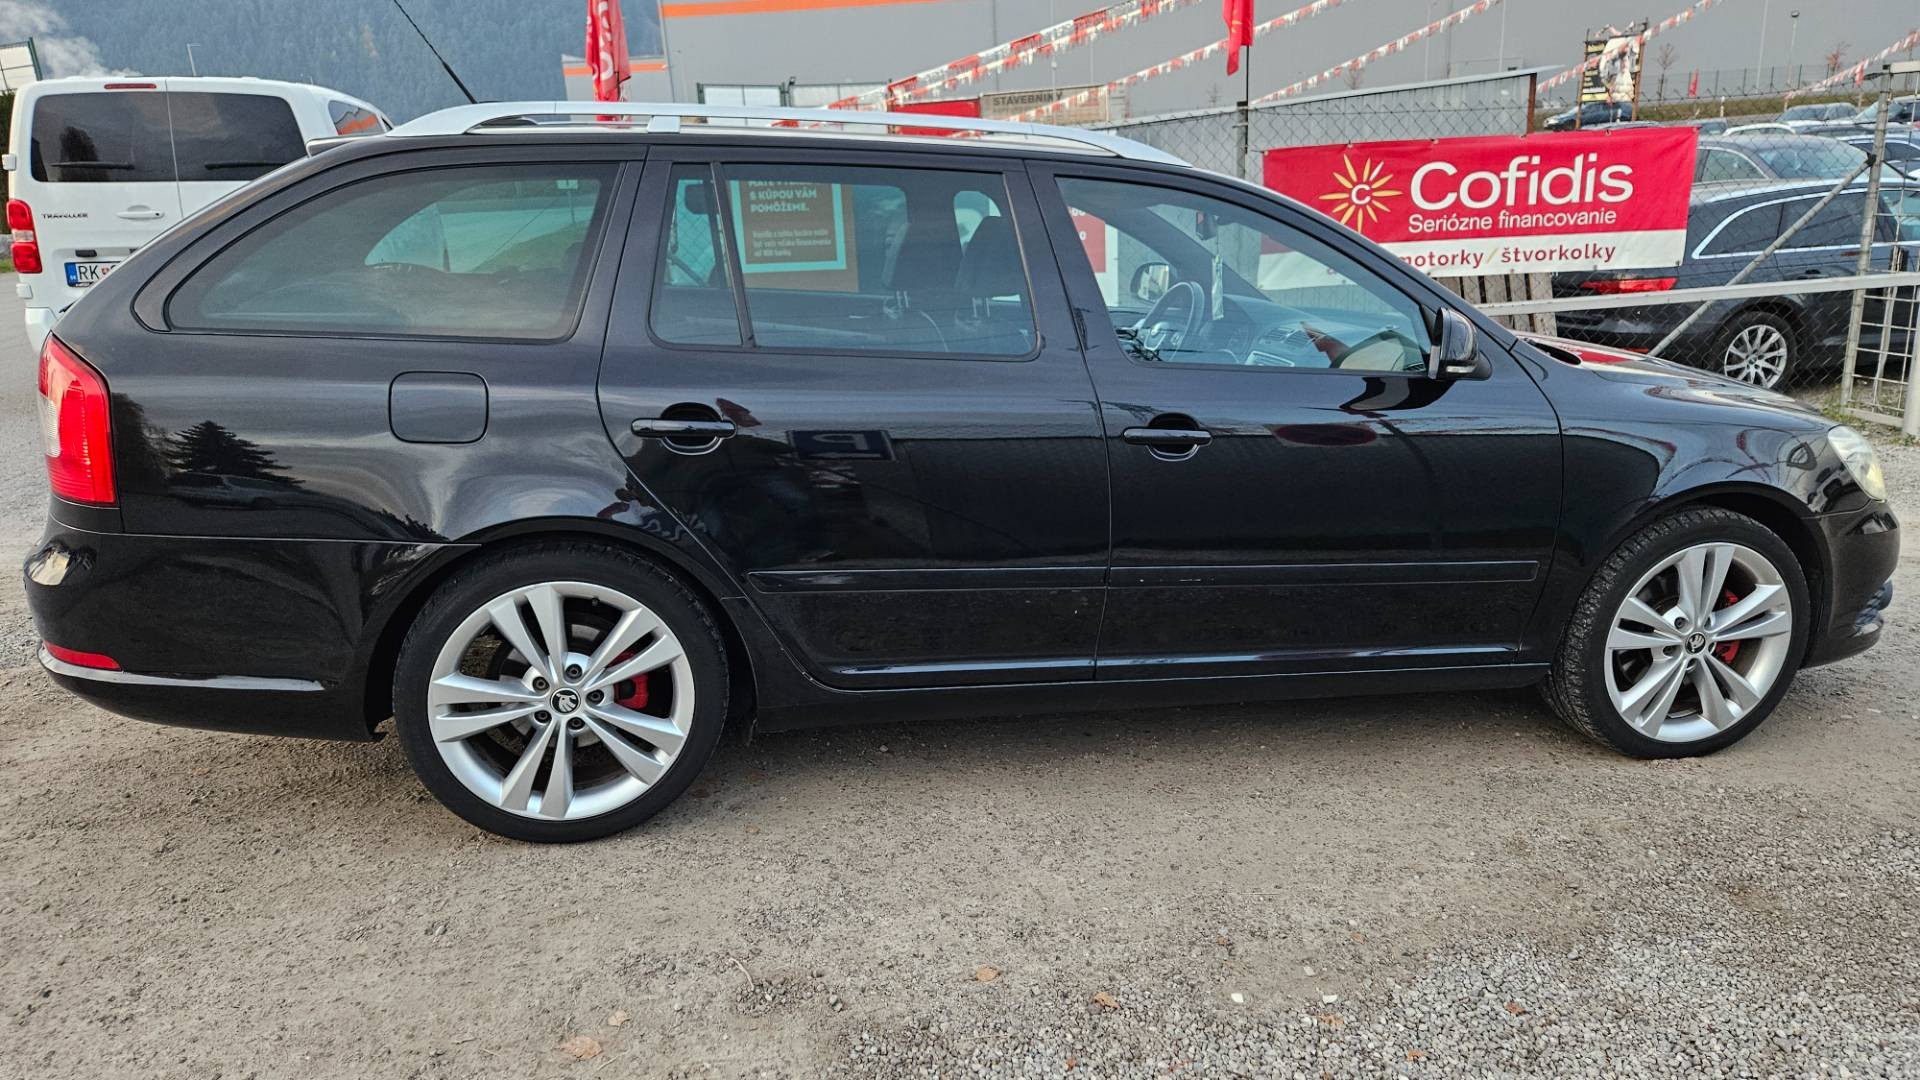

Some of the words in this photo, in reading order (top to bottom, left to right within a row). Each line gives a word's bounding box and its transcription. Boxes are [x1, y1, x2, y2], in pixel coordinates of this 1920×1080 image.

[1410, 152, 1633, 211] Cofidis
[1408, 212, 1493, 233] Seriózne
[1499, 208, 1617, 229] financovanie
[1501, 243, 1616, 264] štvorkolky
